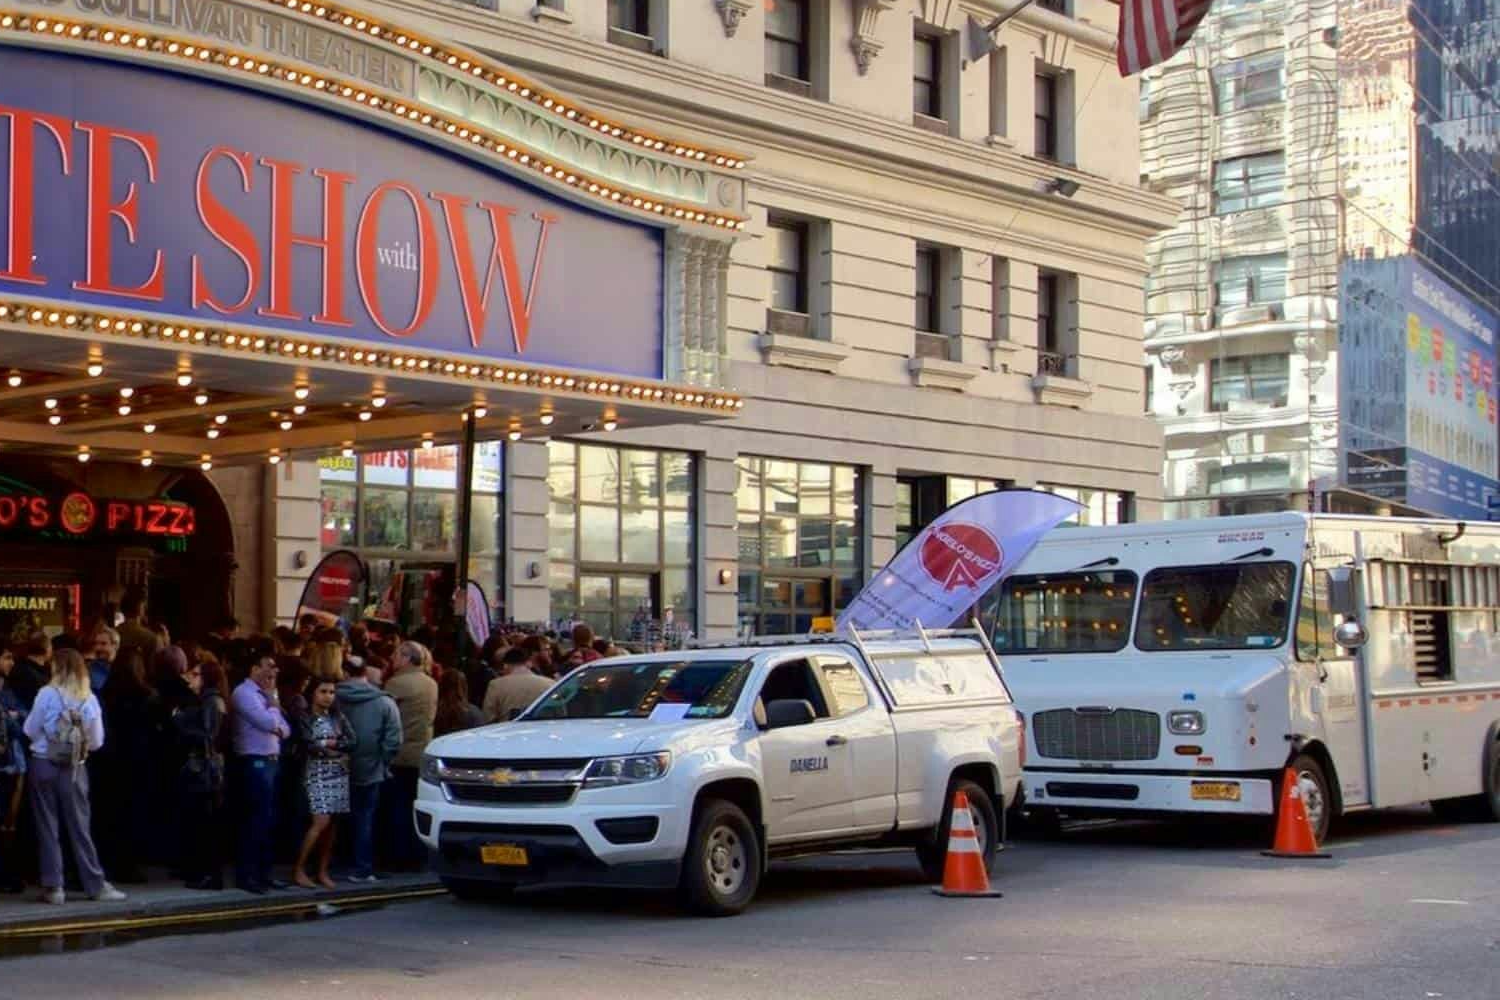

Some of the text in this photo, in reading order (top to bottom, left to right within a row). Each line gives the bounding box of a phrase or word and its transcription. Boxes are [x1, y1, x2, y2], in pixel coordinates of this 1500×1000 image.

[258, 11, 406, 94] THEATER
[191, 144, 558, 355] SHOW
[377, 243, 418, 273] with
